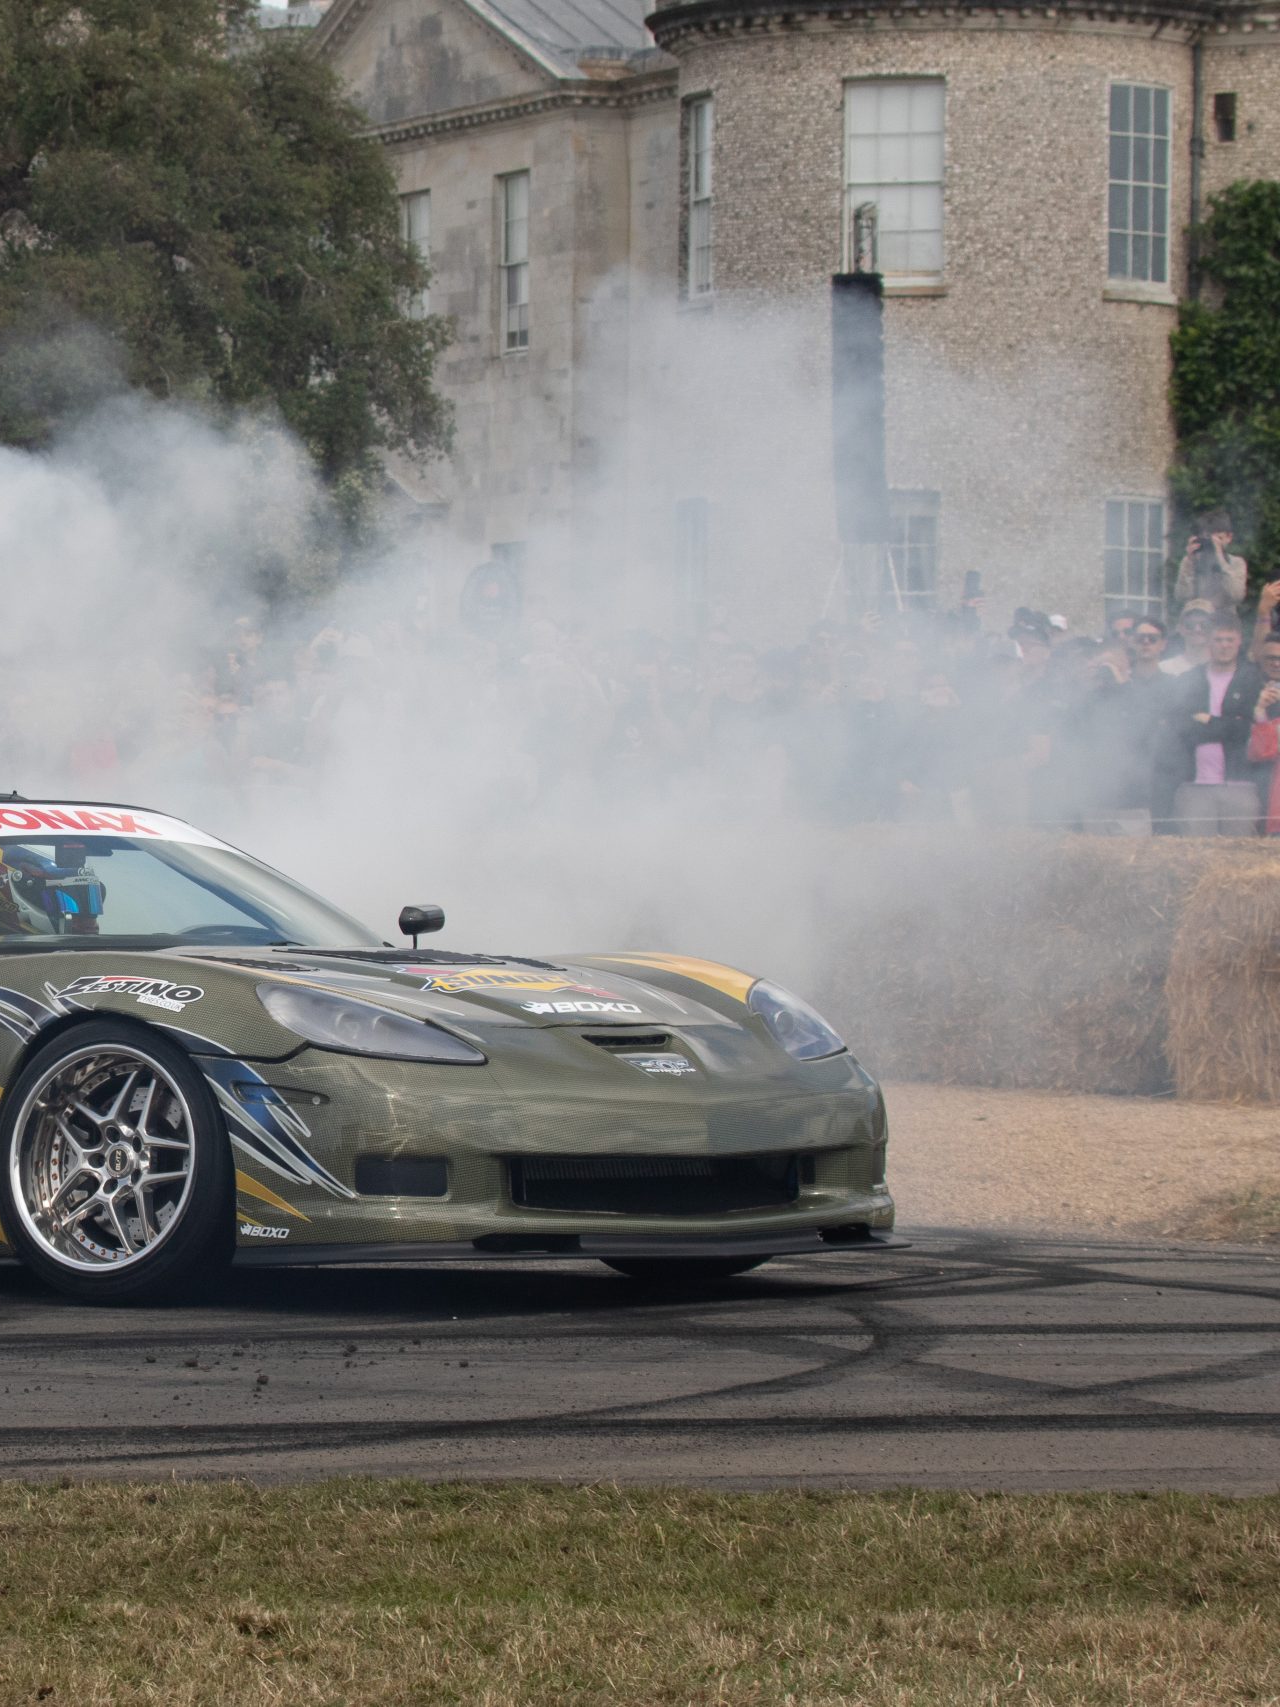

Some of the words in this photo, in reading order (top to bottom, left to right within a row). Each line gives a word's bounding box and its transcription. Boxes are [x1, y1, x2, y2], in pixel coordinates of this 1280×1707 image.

[53, 975, 205, 1003] ZESTINO
[552, 1001, 642, 1014] BOXO
[250, 1225, 290, 1239] BOXO
